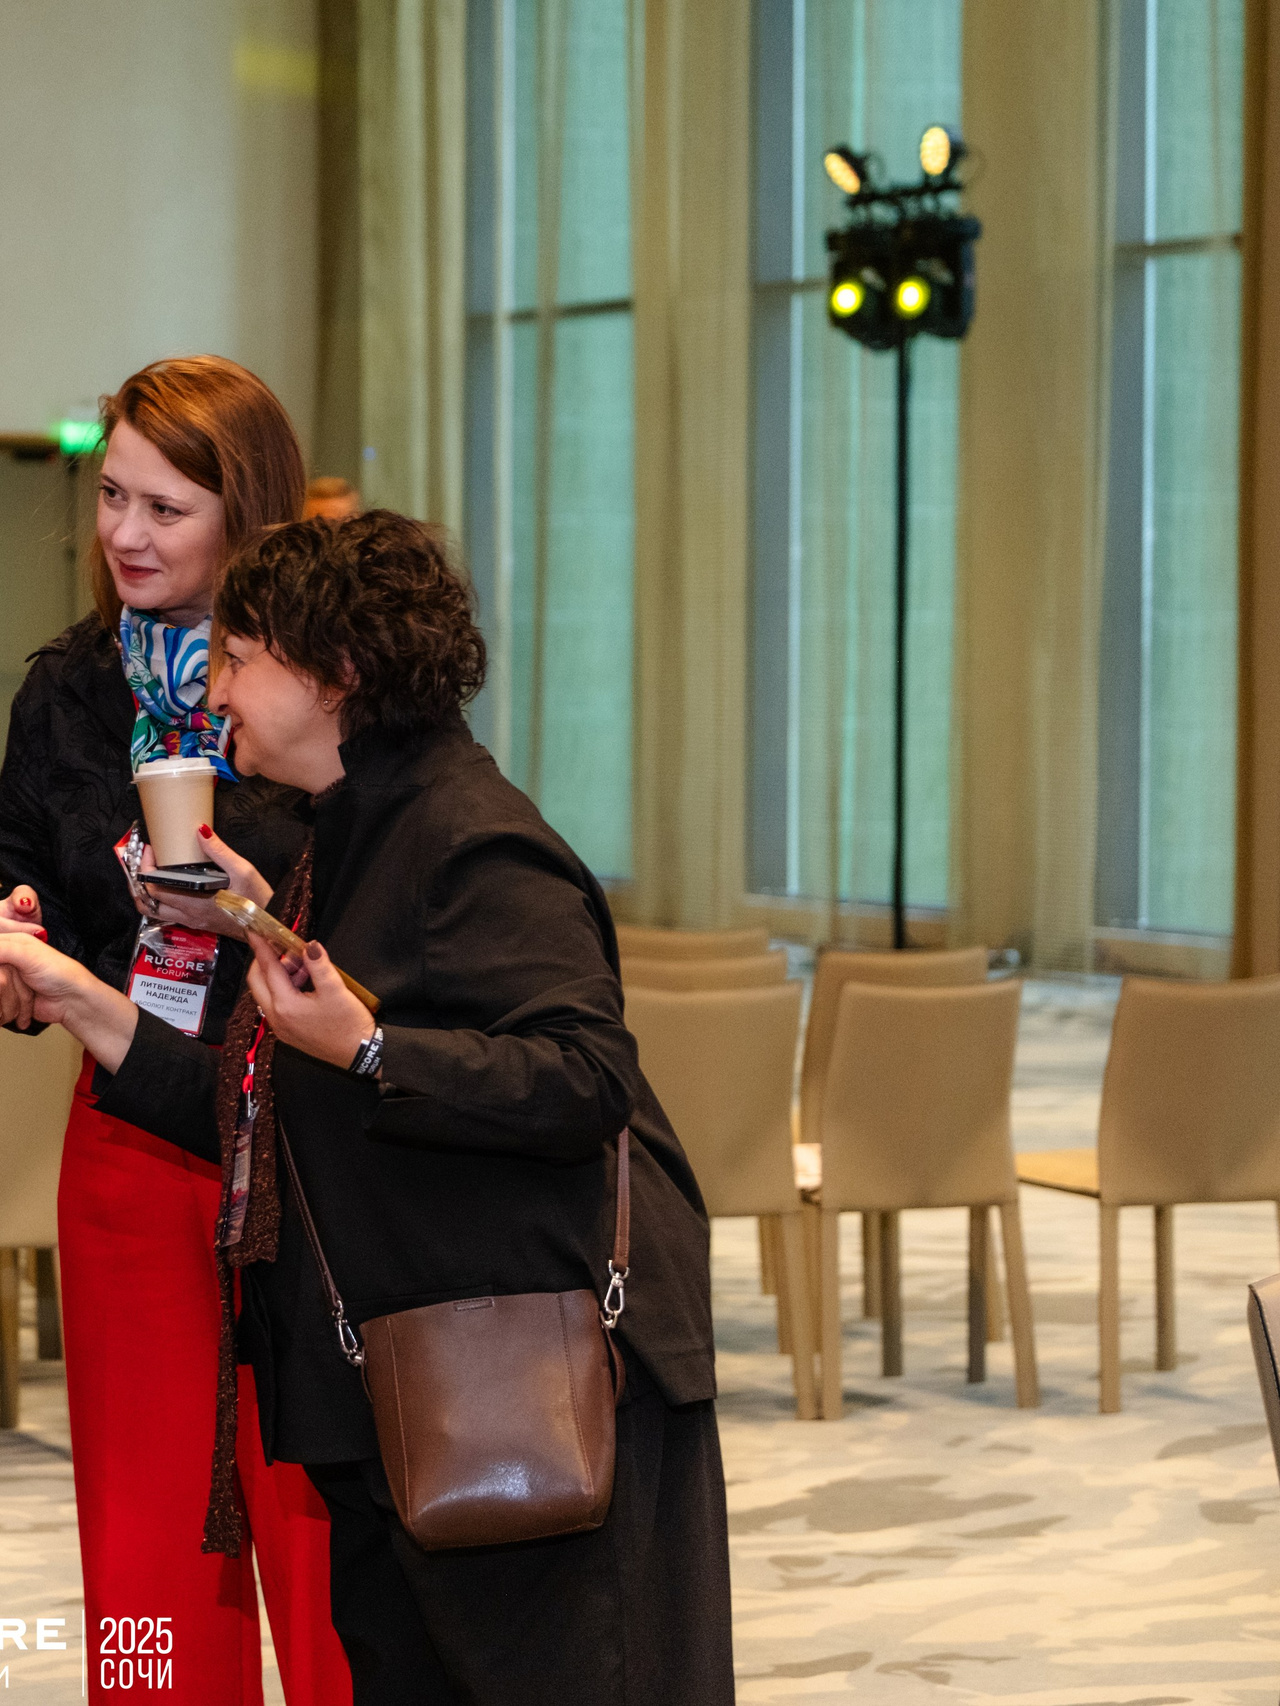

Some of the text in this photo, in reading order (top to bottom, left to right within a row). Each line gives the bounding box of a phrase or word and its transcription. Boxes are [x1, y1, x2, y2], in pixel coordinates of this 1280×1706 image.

[144, 954, 205, 972] RUCORE
[156, 967, 190, 978] FORUM
[140, 980, 198, 997] ЛИТВИНЦЕВА
[146, 990, 189, 1004] НАДЕЖДА
[166, 1005, 198, 1016] КОНТРАКТ
